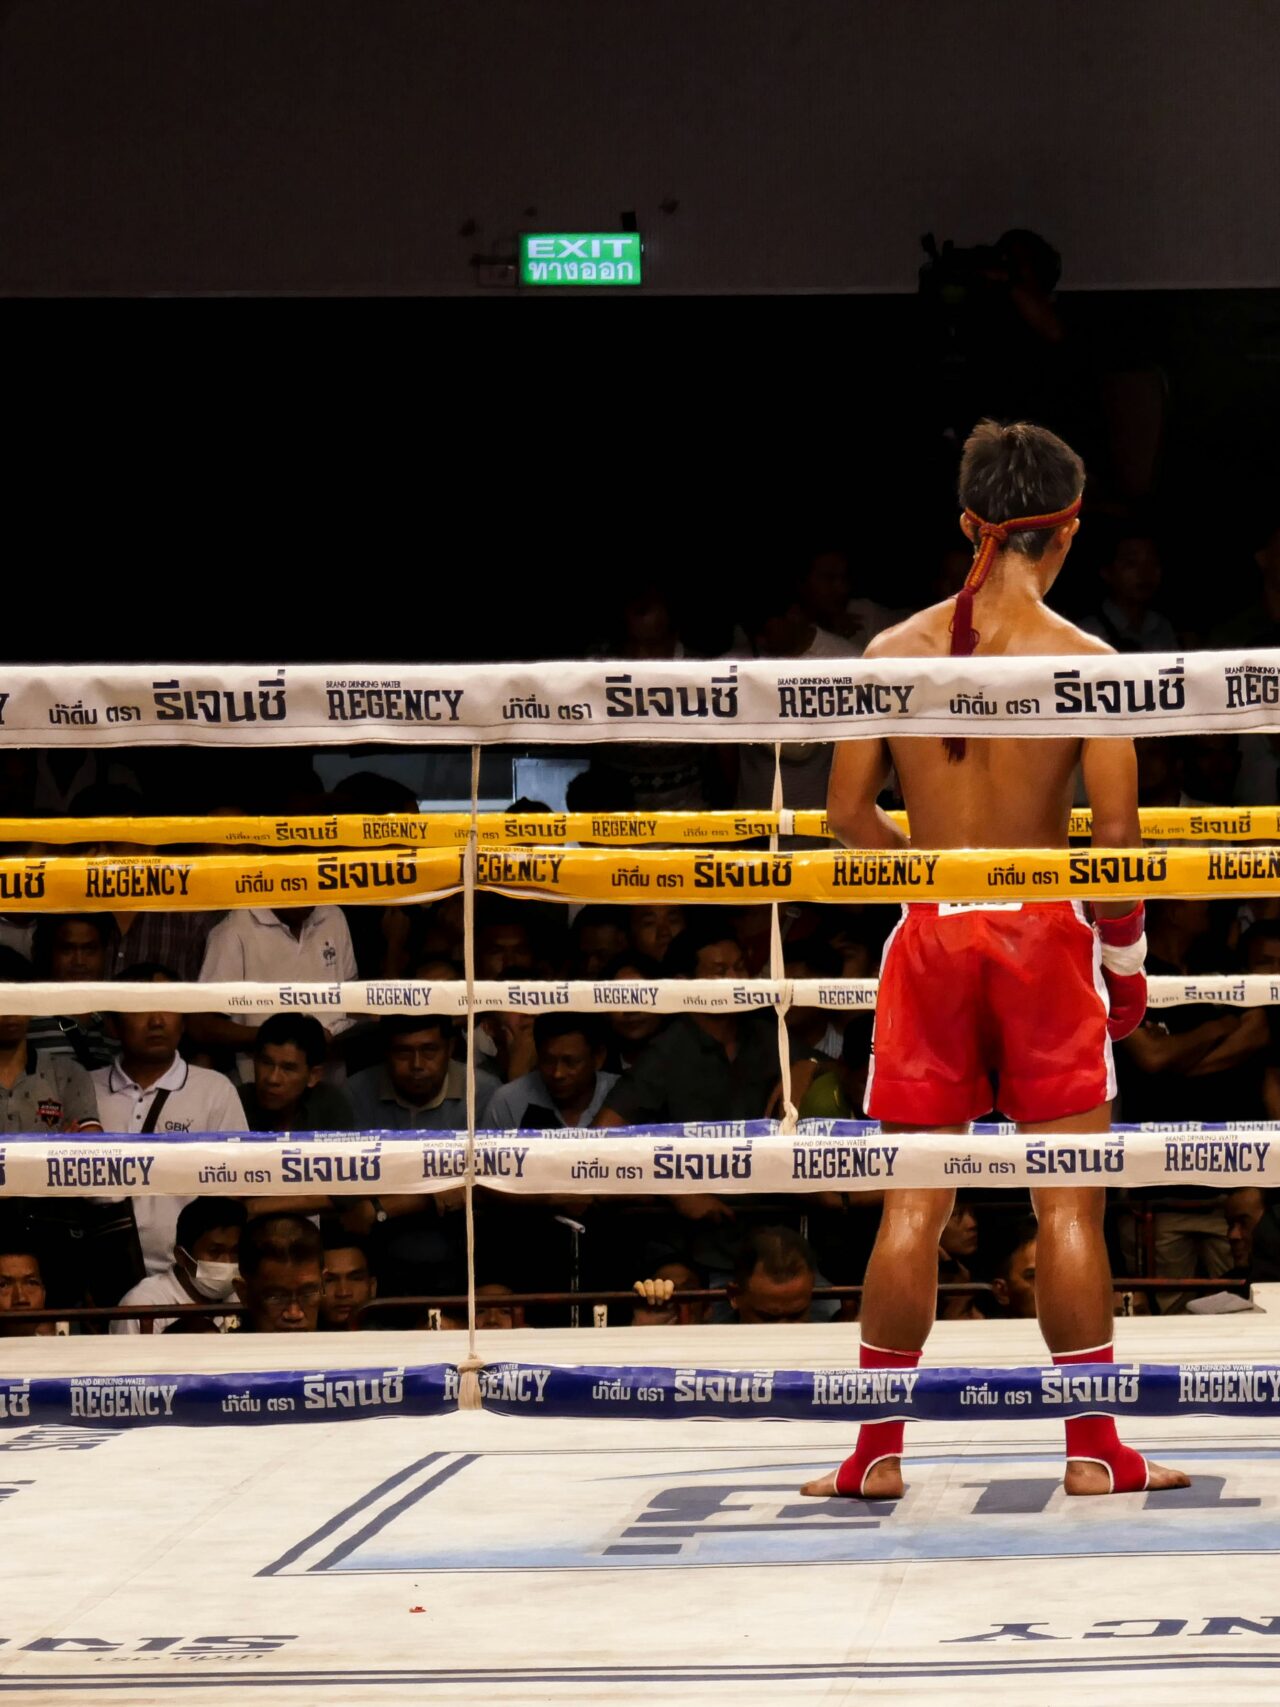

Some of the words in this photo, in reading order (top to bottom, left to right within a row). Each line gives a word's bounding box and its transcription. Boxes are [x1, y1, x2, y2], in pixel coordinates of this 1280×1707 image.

[528, 239, 633, 258] EXIT
[528, 261, 633, 280] ทางออก
[778, 678, 798, 686] BRAND
[832, 677, 852, 685] WATER
[1225, 667, 1244, 676] BRAND
[1246, 666, 1276, 675] DRINKING
[49, 701, 98, 724] น้ำดื่ม
[106, 704, 141, 722] ตรา
[153, 669, 287, 722] รีเจนซี่
[326, 681, 345, 689] BRAND
[347, 681, 379, 689] DRINKING
[381, 681, 401, 689] WATER
[502, 695, 550, 719] น้ำดื่ม
[558, 702, 593, 719] ตรา
[605, 665, 738, 718] รีเจนซี่
[949, 693, 997, 716] น้ำดื่ม
[1006, 696, 1040, 715] ตรา
[1054, 658, 1185, 714] รีเจนซี่
[327, 689, 464, 721] REGENCY
[778, 685, 914, 719] REGENCY
[275, 815, 339, 841] รีเจนซี่
[363, 821, 429, 841] REGENCY
[504, 815, 567, 838] รีเจนซี่
[591, 820, 658, 838] REGENCY
[1190, 811, 1252, 835] รีเจนซี่
[85, 864, 194, 899] REGENCY
[235, 871, 273, 893] น้ำดื่ม
[281, 877, 308, 892] ตรา
[317, 849, 418, 890] รีเจนซี่
[611, 866, 650, 888] น้ำดื่ม
[656, 872, 684, 888] ตรา
[832, 855, 940, 887] REGENCY
[987, 864, 1026, 886] น้ำดื่ม
[1032, 869, 1059, 886] ตรา
[280, 982, 342, 1006] รีเจนซี่
[366, 987, 432, 1007] REGENCY
[508, 983, 569, 1006] รีเจนซี่
[593, 987, 659, 1007] REGENCY
[165, 1120, 192, 1134] GBK
[198, 1163, 238, 1184] น้ำดื่ม
[244, 1168, 272, 1184] ตรา
[281, 1142, 382, 1182] รีเจนซี่
[571, 1158, 610, 1180] น้ำดื่ม
[616, 1164, 643, 1180] ตรา
[653, 1139, 753, 1180] รีเจนซี่
[792, 1147, 899, 1179] REGENCY
[944, 1155, 982, 1175] น้ำดื่ม
[989, 1160, 1016, 1175] ตรา
[1026, 1136, 1125, 1175] รีเจนซี่
[1164, 1142, 1270, 1173] REGENCY
[47, 1156, 155, 1187] REGENCY
[92, 1378, 122, 1386] DRINKING
[223, 1394, 261, 1413] น้ำดื่ม
[267, 1397, 295, 1412] ตรา
[304, 1366, 406, 1410] รีเจนซี่
[592, 1380, 632, 1402] น้ำดื่ม
[637, 1388, 665, 1402] ตรา
[812, 1372, 920, 1404] REGENCY
[960, 1384, 999, 1405] น้ำดื่ม
[1005, 1391, 1032, 1405] ตรา
[1041, 1363, 1140, 1404] รีเจนซี่
[70, 1385, 178, 1419] REGENCY
